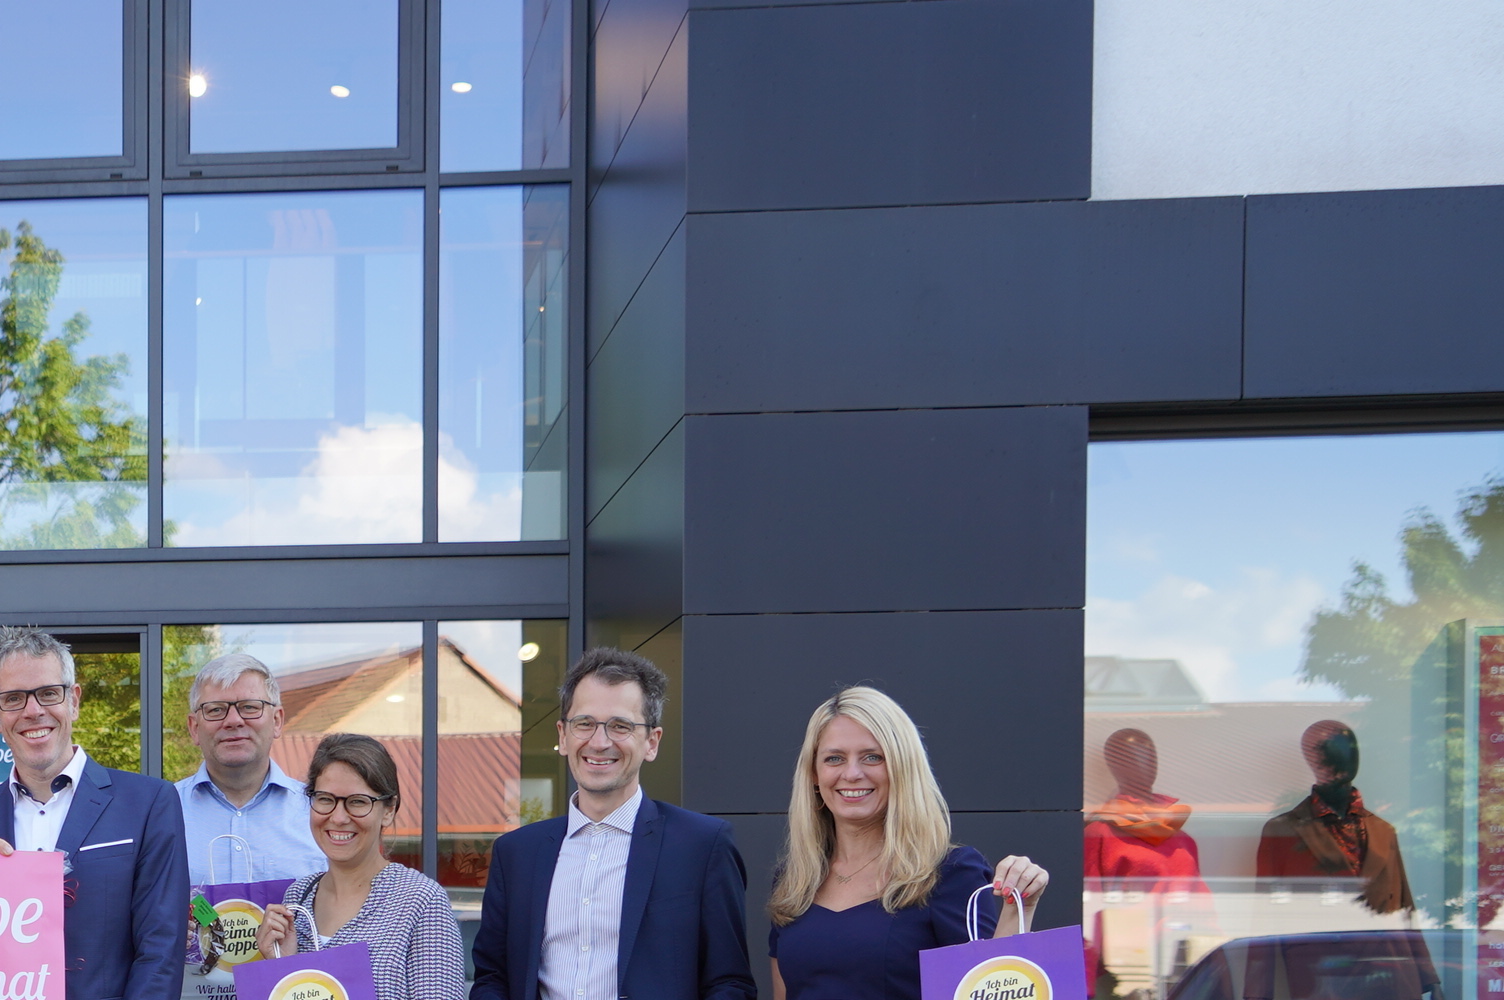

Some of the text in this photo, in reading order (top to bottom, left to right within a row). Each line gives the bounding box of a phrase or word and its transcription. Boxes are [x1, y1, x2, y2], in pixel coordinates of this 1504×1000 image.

[222, 918, 248, 927] Ich bin
[224, 925, 260, 940] eima
[985, 976, 1018, 990] Ich bin
[196, 984, 236, 994] Wir halt
[292, 989, 320, 1000] Ich bin
